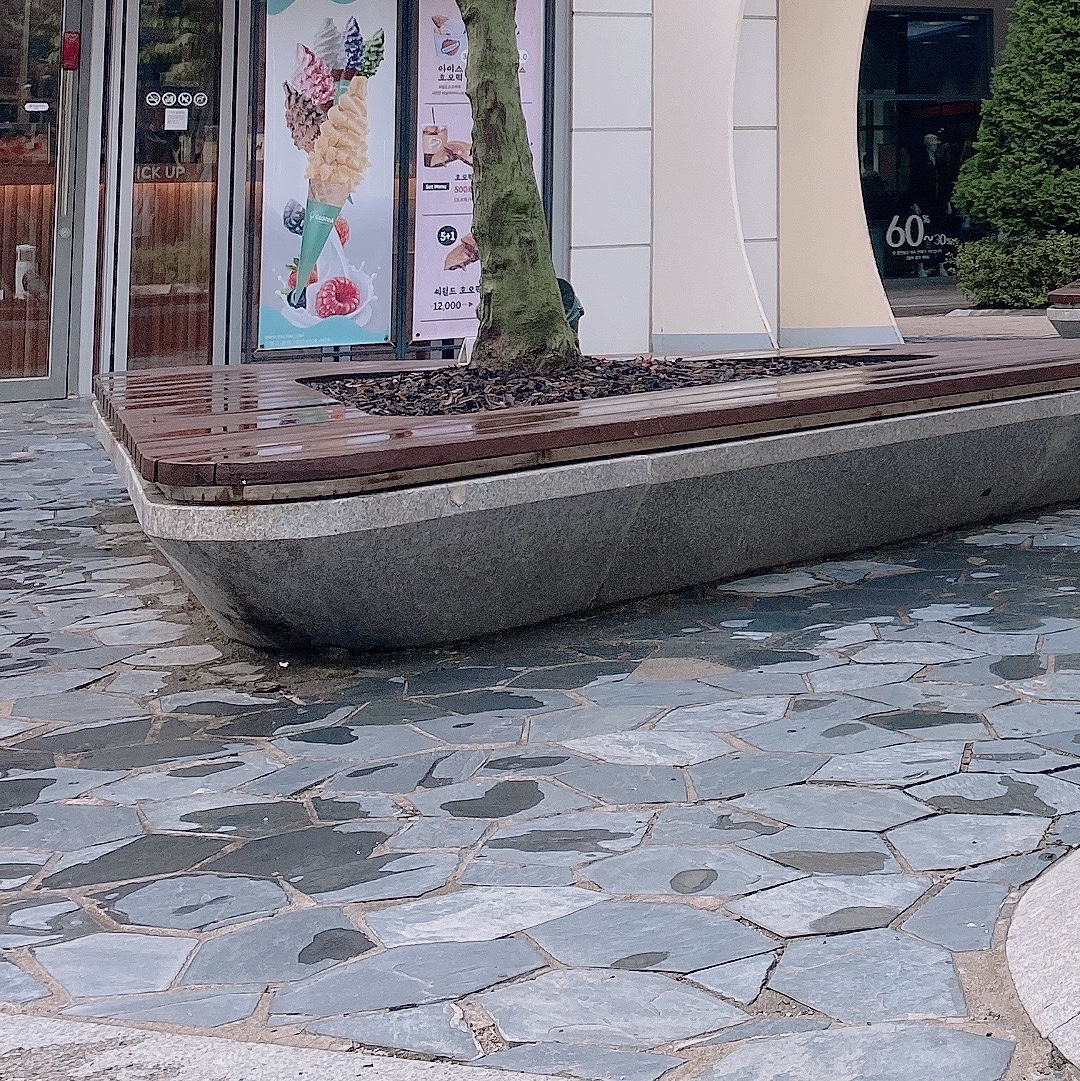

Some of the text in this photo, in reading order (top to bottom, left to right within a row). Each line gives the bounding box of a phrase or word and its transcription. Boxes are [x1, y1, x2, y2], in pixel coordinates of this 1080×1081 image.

[438, 63, 463, 72] 아이스
[136, 165, 186, 180] ICK UP
[440, 230, 456, 242] 5+1
[433, 300, 462, 311] 12,000
